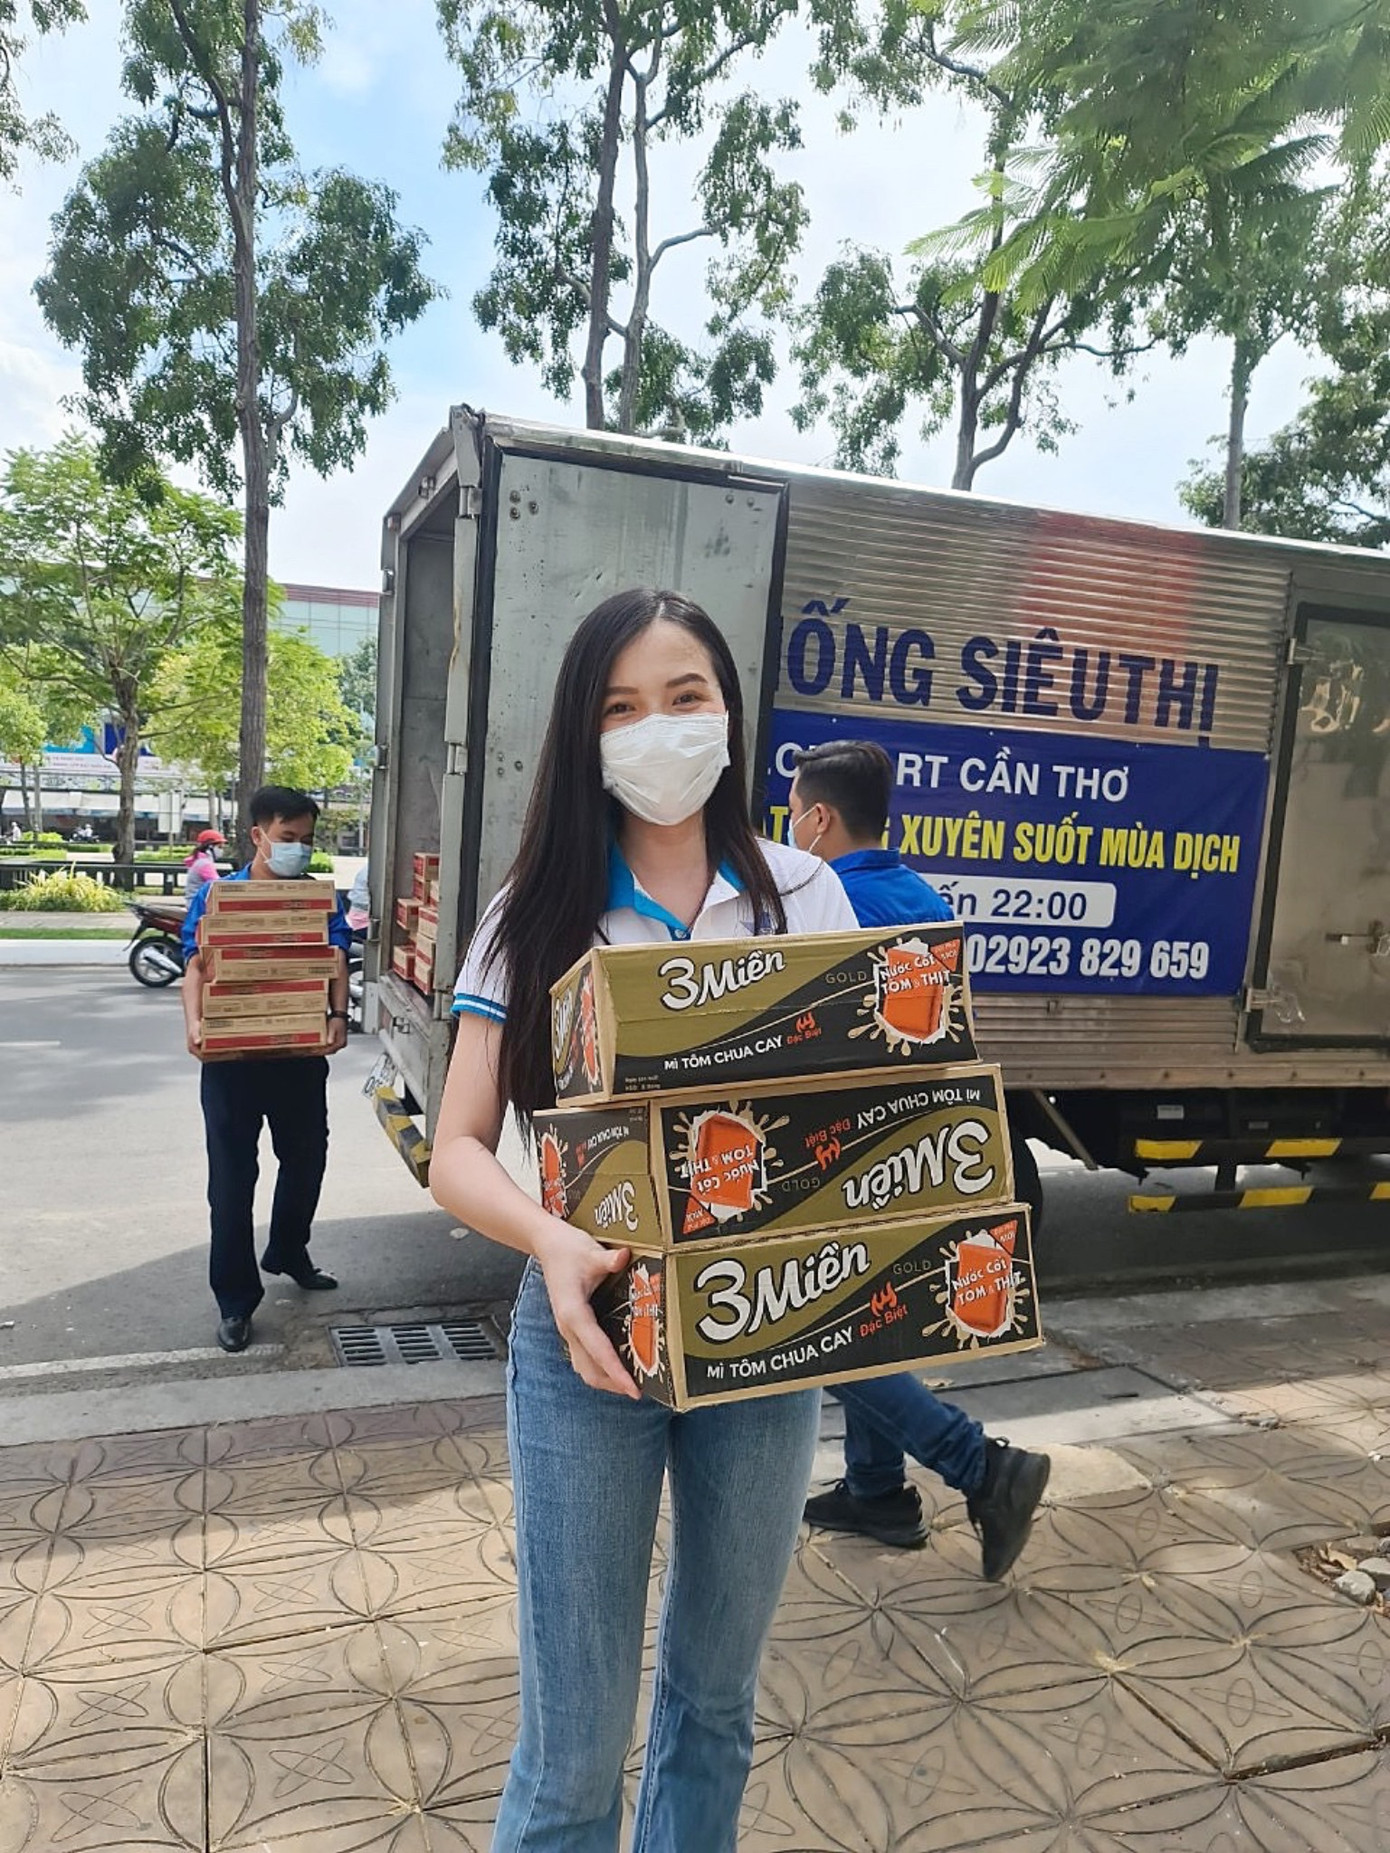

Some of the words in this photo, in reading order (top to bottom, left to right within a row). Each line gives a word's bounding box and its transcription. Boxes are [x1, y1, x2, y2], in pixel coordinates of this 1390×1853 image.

[959, 746, 1041, 796] CẦN
[1053, 765, 1130, 801] THƠ
[899, 811, 1006, 860] XUYÊN
[1013, 812, 1094, 866] SUỐT
[1100, 821, 1166, 869] MÙA
[1173, 834, 1241, 880] DỊCH
[990, 888, 1088, 921] 22:00
[967, 932, 1071, 975] 02923
[1079, 939, 1140, 978] 829
[1149, 942, 1210, 979] 659
[825, 970, 868, 985] GOLD
[681, 1053, 712, 1069] TÔM
[714, 1046, 753, 1064] CHUA
[755, 1034, 783, 1053] CAY
[888, 1092, 930, 1114] CHUA
[932, 1089, 962, 1105] TÔM
[855, 1106, 887, 1129] CAY
[892, 1260, 932, 1276] GOLD
[730, 1358, 766, 1377] TÔM
[770, 1345, 819, 1371] CHUA
[820, 1326, 854, 1353] CAY
